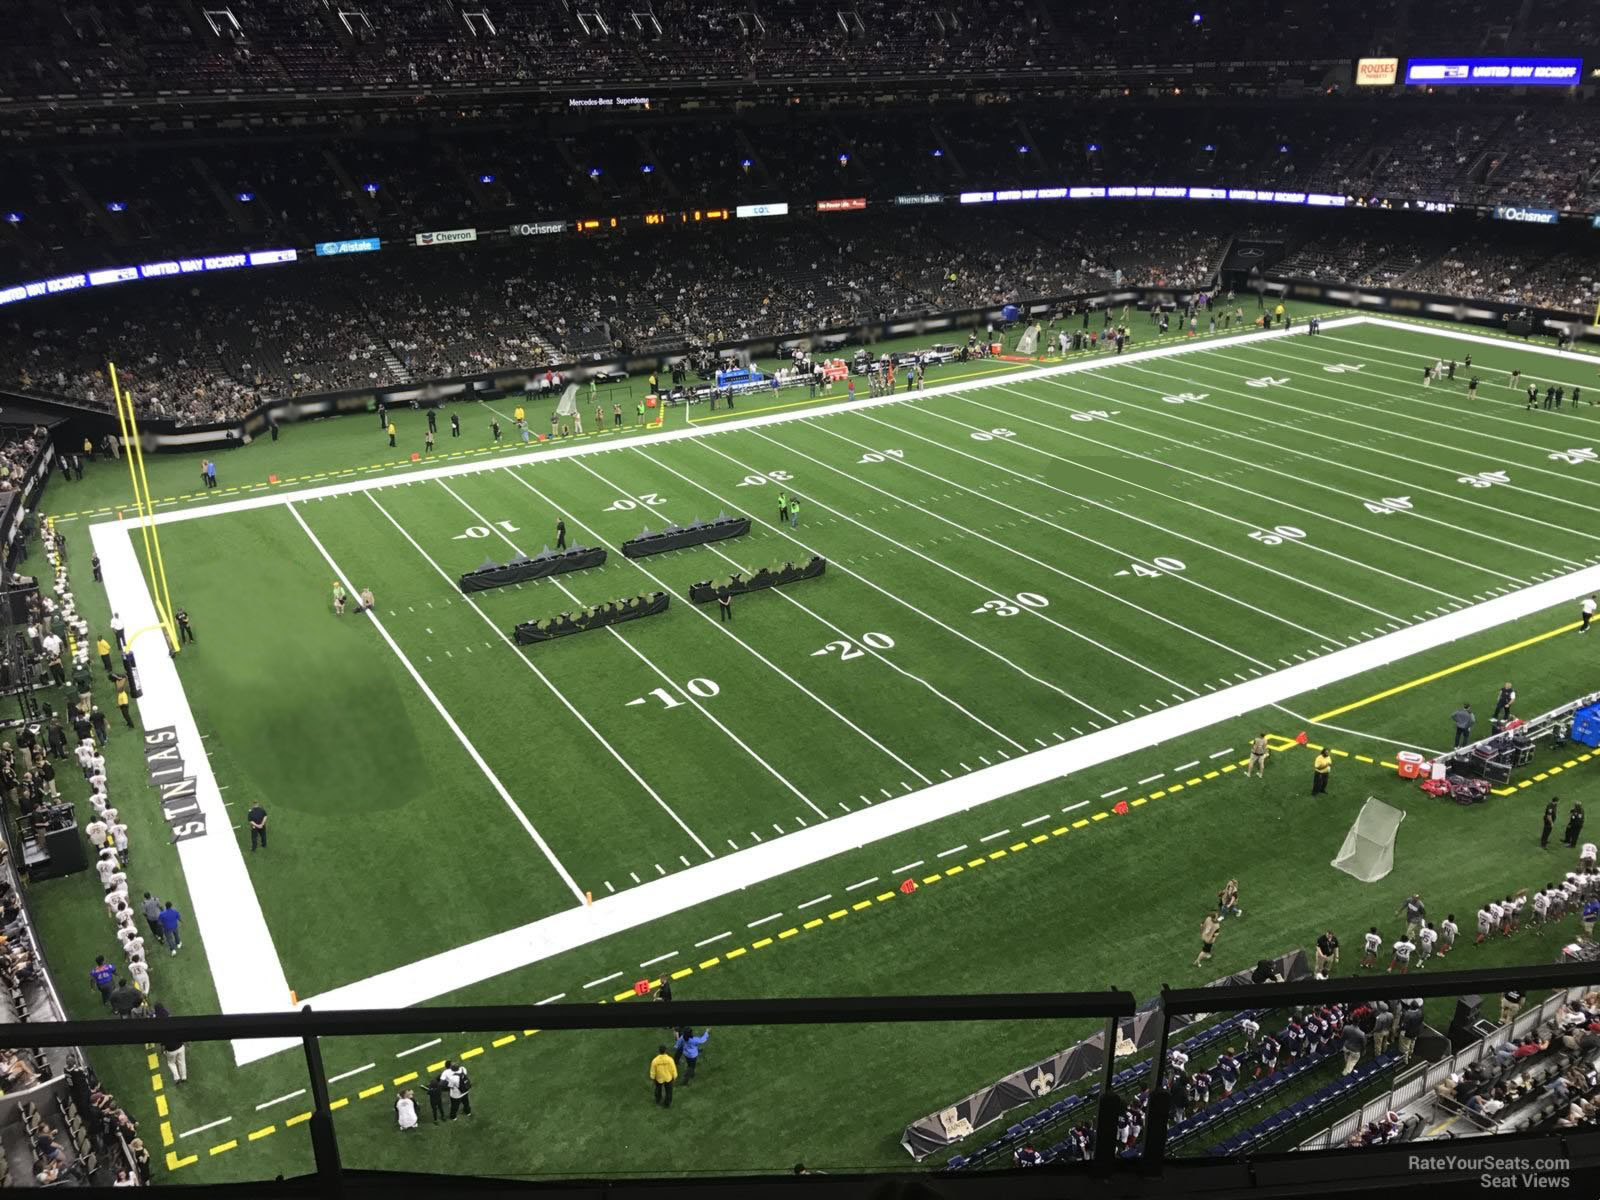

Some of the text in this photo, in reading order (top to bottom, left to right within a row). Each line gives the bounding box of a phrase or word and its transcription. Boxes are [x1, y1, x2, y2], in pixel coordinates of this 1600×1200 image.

[1360, 64, 1395, 73] ROUSES
[1472, 67, 1510, 77] UNITED
[1511, 67, 1533, 78] WAY
[569, 97, 650, 106] Mercedes-Benz Superdome
[1506, 207, 1553, 222] Ochsner
[436, 232, 472, 241] Chevron
[520, 223, 563, 235] Ochsner
[339, 241, 372, 253] Allstate
[141, 262, 180, 277] UNITED
[179, 259, 203, 272] WAY
[204, 254, 246, 270] KICKOFF
[970, 427, 1017, 441] 50
[862, 449, 904, 463] 40
[744, 470, 794, 486] 30
[1457, 471, 1511, 488] 30
[613, 493, 668, 511] 20
[1363, 497, 1414, 514] 40
[465, 520, 520, 538] 10
[1247, 525, 1306, 545] 50
[1131, 556, 1186, 578] 40
[984, 592, 1049, 617] 30
[825, 631, 895, 661] 20
[648, 677, 720, 709] 10
[144, 731, 206, 836] SAINTS
